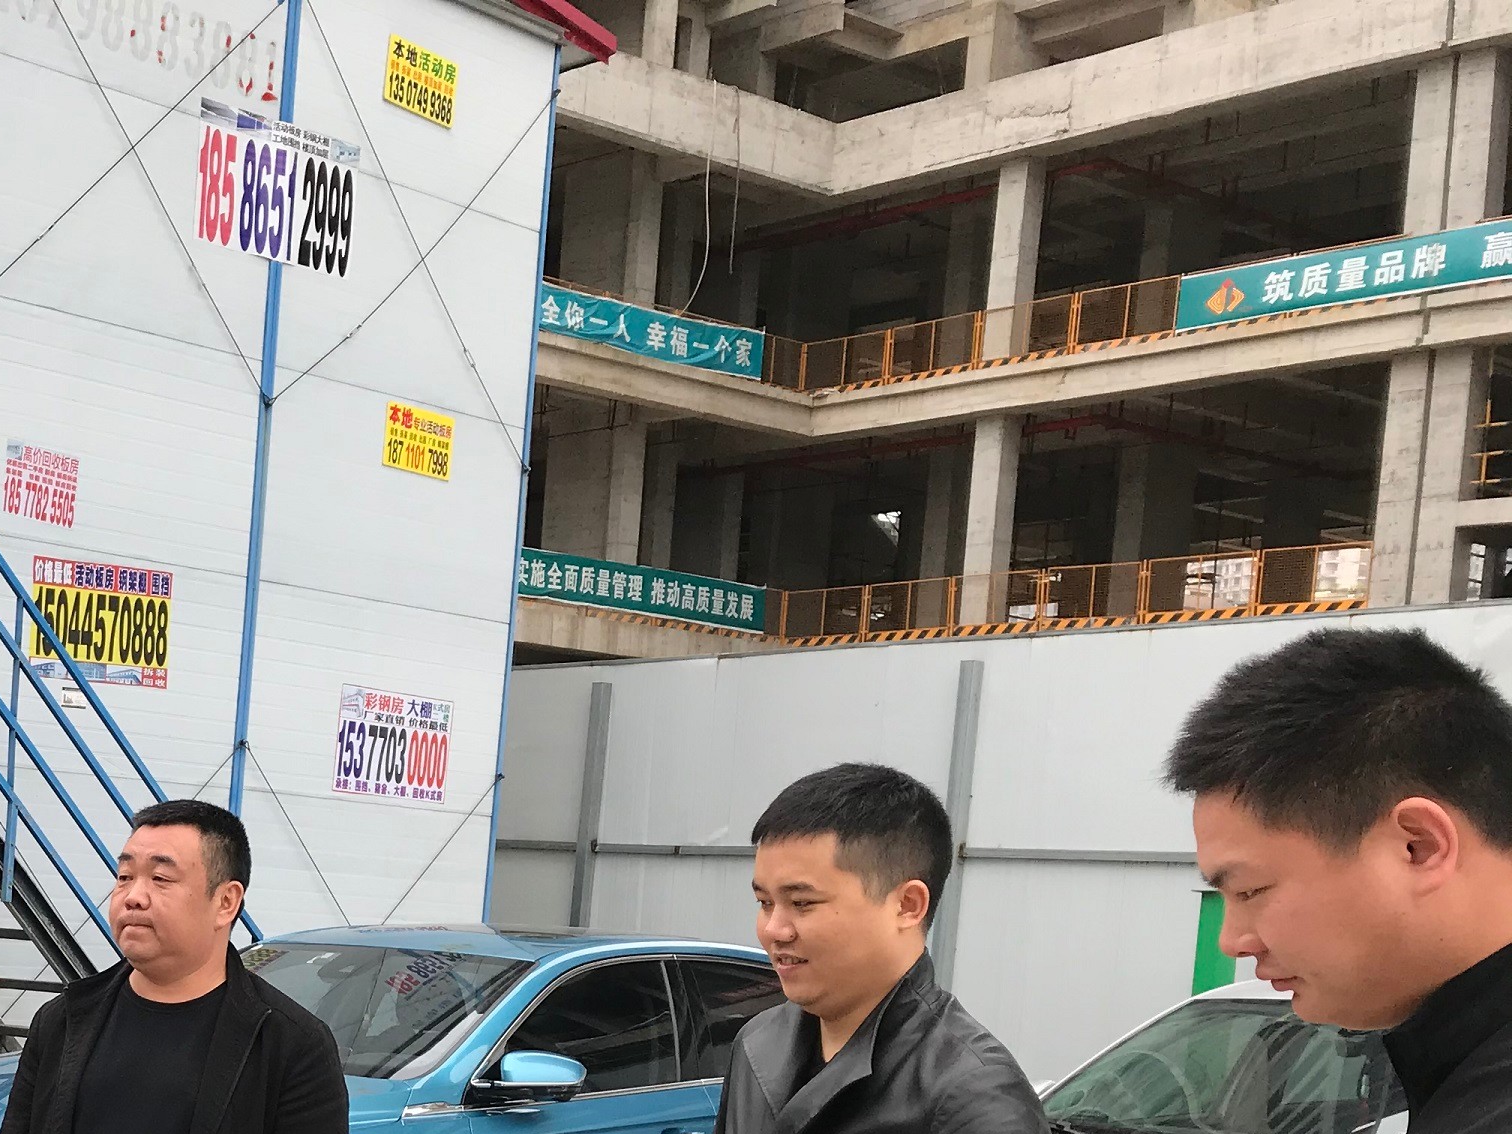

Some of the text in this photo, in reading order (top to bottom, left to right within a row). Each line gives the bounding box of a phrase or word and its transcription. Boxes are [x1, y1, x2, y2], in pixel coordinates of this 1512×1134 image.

[393, 39, 456, 84] 本地活动房
[390, 71, 405, 103] 135
[198, 126, 353, 277] 185 8651 2999
[1261, 242, 1446, 305] 筑质量品牌
[646, 321, 752, 367] 幸福一个家
[24, 445, 79, 475] 高价回收板房
[388, 438, 404, 465] 187
[406, 443, 425, 471] 1101
[428, 448, 448, 476] 7998
[3, 475, 22, 514] 185
[24, 481, 49, 521] 7782
[50, 489, 75, 528] 5505
[35, 559, 72, 585] 价格最低
[75, 565, 114, 590] 活动板房
[151, 573, 170, 597] 围挡
[518, 556, 754, 621] 实施全面质量管理 推动高质量发展
[34, 586, 168, 667] 15044570888
[363, 711, 448, 732] 厂家直销 价格最低
[364, 692, 433, 719] 彩钢房 大棚
